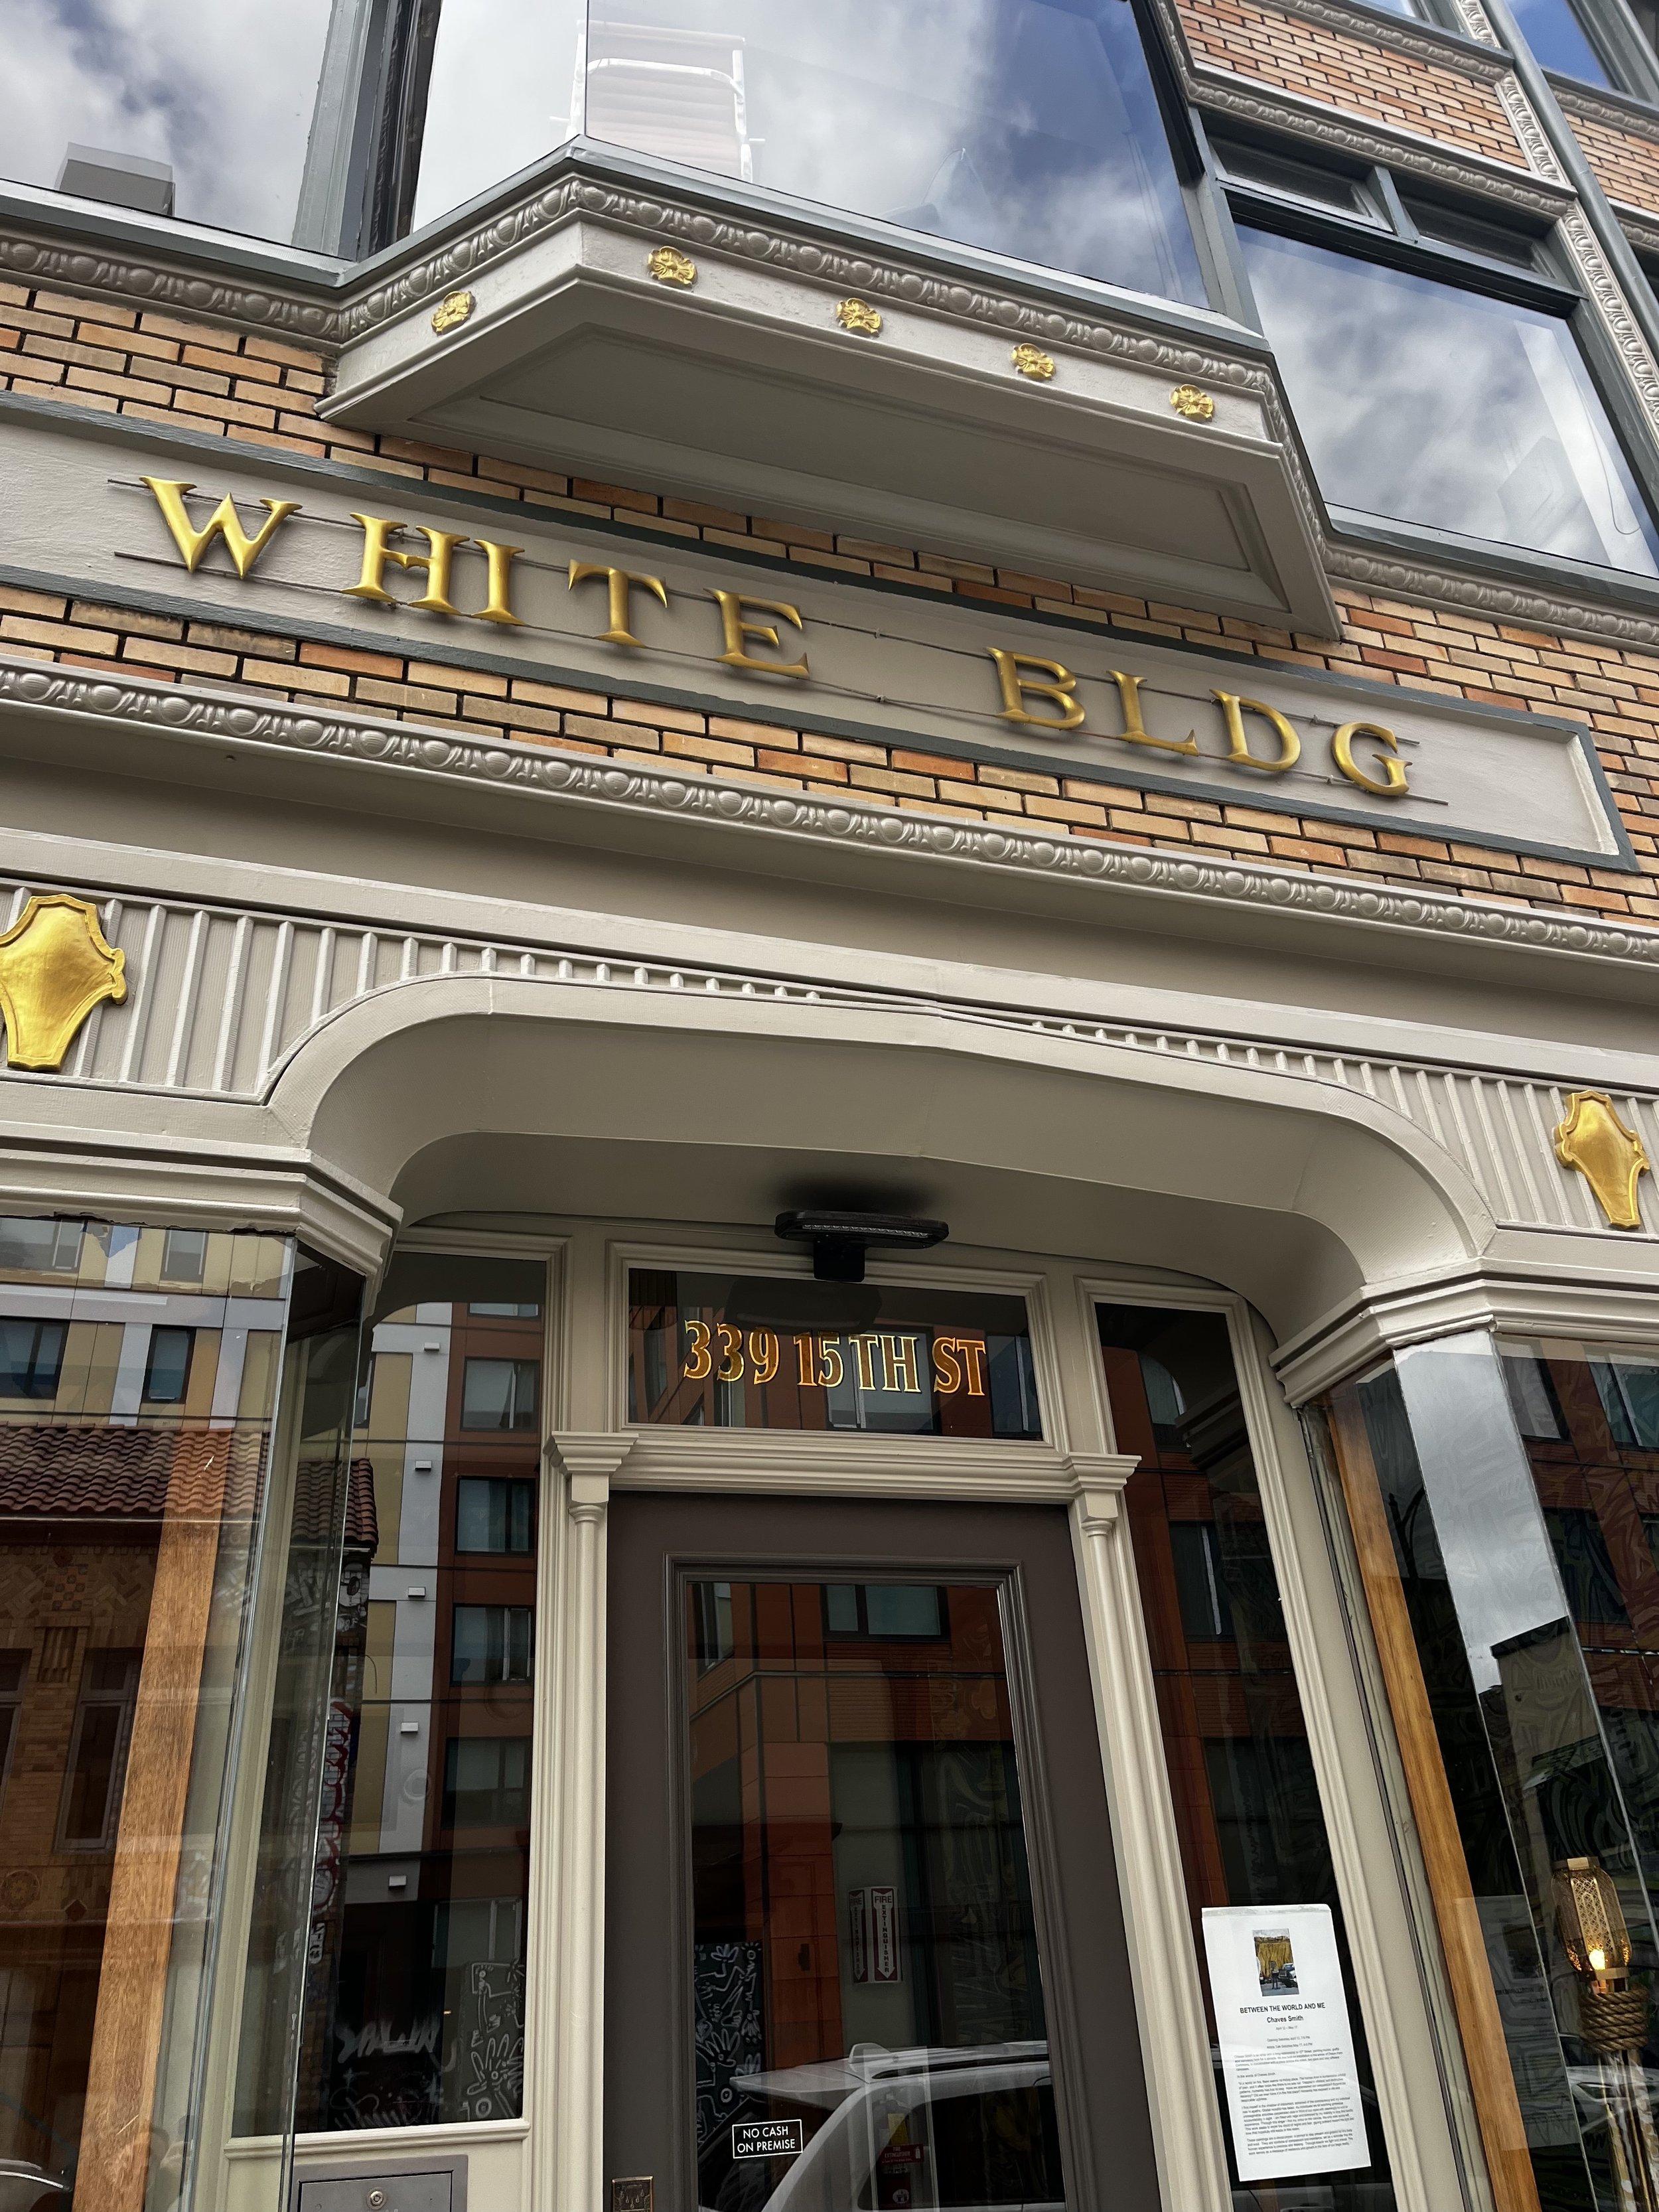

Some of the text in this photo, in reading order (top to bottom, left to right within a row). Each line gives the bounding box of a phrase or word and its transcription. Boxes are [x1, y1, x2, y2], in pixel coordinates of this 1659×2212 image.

[139, 475, 1413, 796] WHITE BLDG
[683, 1319, 987, 1396] 339 15TH ST
[737, 2138, 796, 2153] ON PREMISE
[743, 2126, 788, 2139] NO CASH
